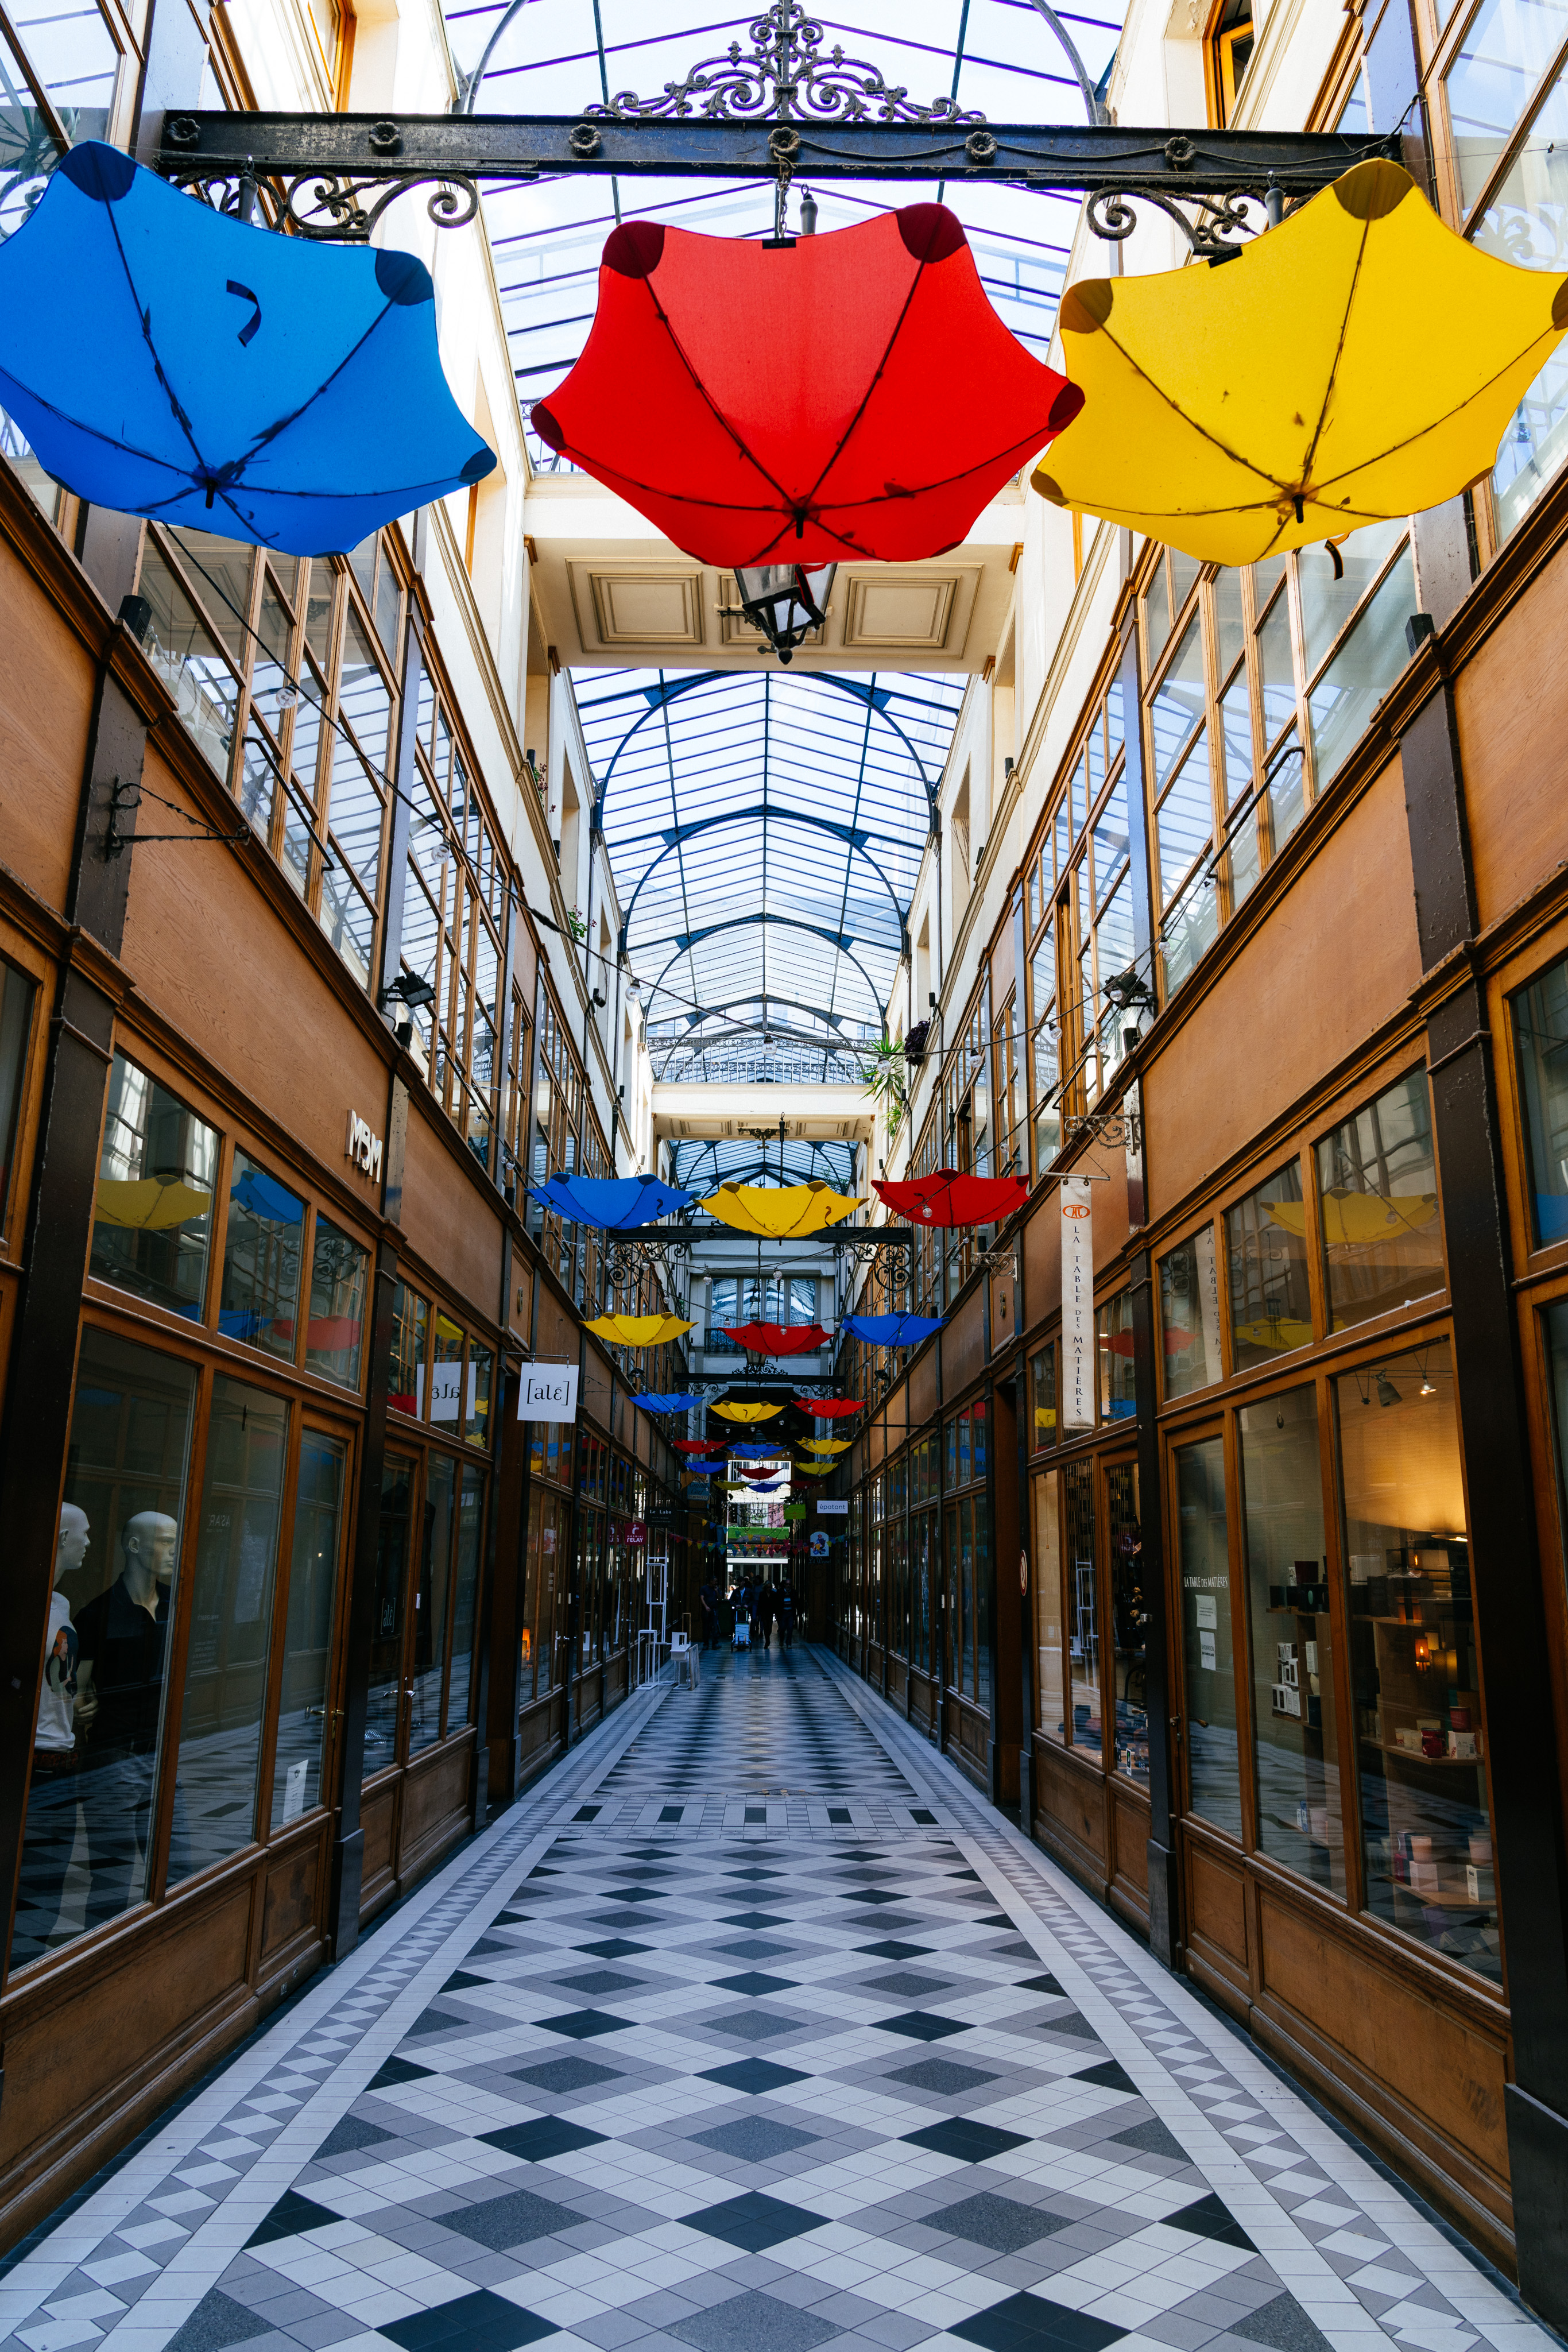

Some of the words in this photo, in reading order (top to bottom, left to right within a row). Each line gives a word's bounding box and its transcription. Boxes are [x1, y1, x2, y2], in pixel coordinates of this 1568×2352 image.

[345, 1109, 383, 1183] MBM
[1073, 1226, 1081, 1243] LA
[1073, 1255, 1081, 1303] TABLE
[1073, 1336, 1083, 1416] MATIÈRES
[1184, 1576, 1189, 1587] LA
[1189, 1576, 1201, 1587] TABLE
[1207, 1574, 1228, 1588] MATIÈRES
